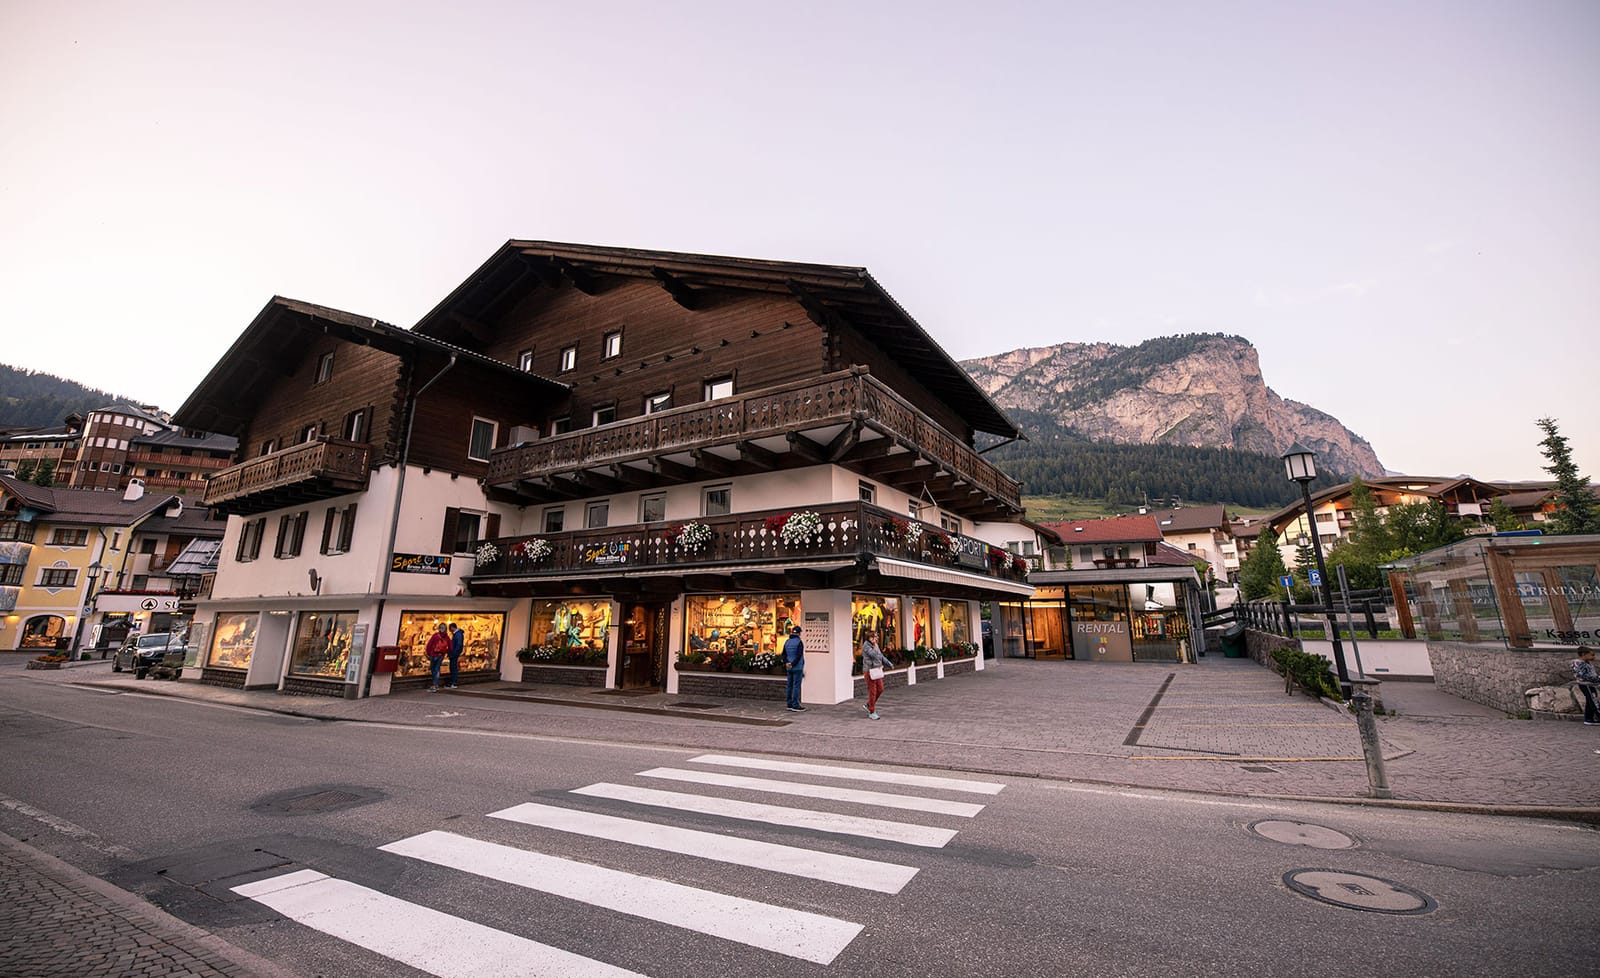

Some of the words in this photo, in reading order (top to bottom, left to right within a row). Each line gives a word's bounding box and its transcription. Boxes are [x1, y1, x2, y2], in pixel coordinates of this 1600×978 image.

[958, 536, 981, 557] SPORT
[393, 555, 422, 569] Sport
[1312, 573, 1320, 581] P
[1507, 586, 1577, 596] ENTRATA
[1077, 623, 1124, 633] RENTAL
[1545, 628, 1590, 639] Kassa
